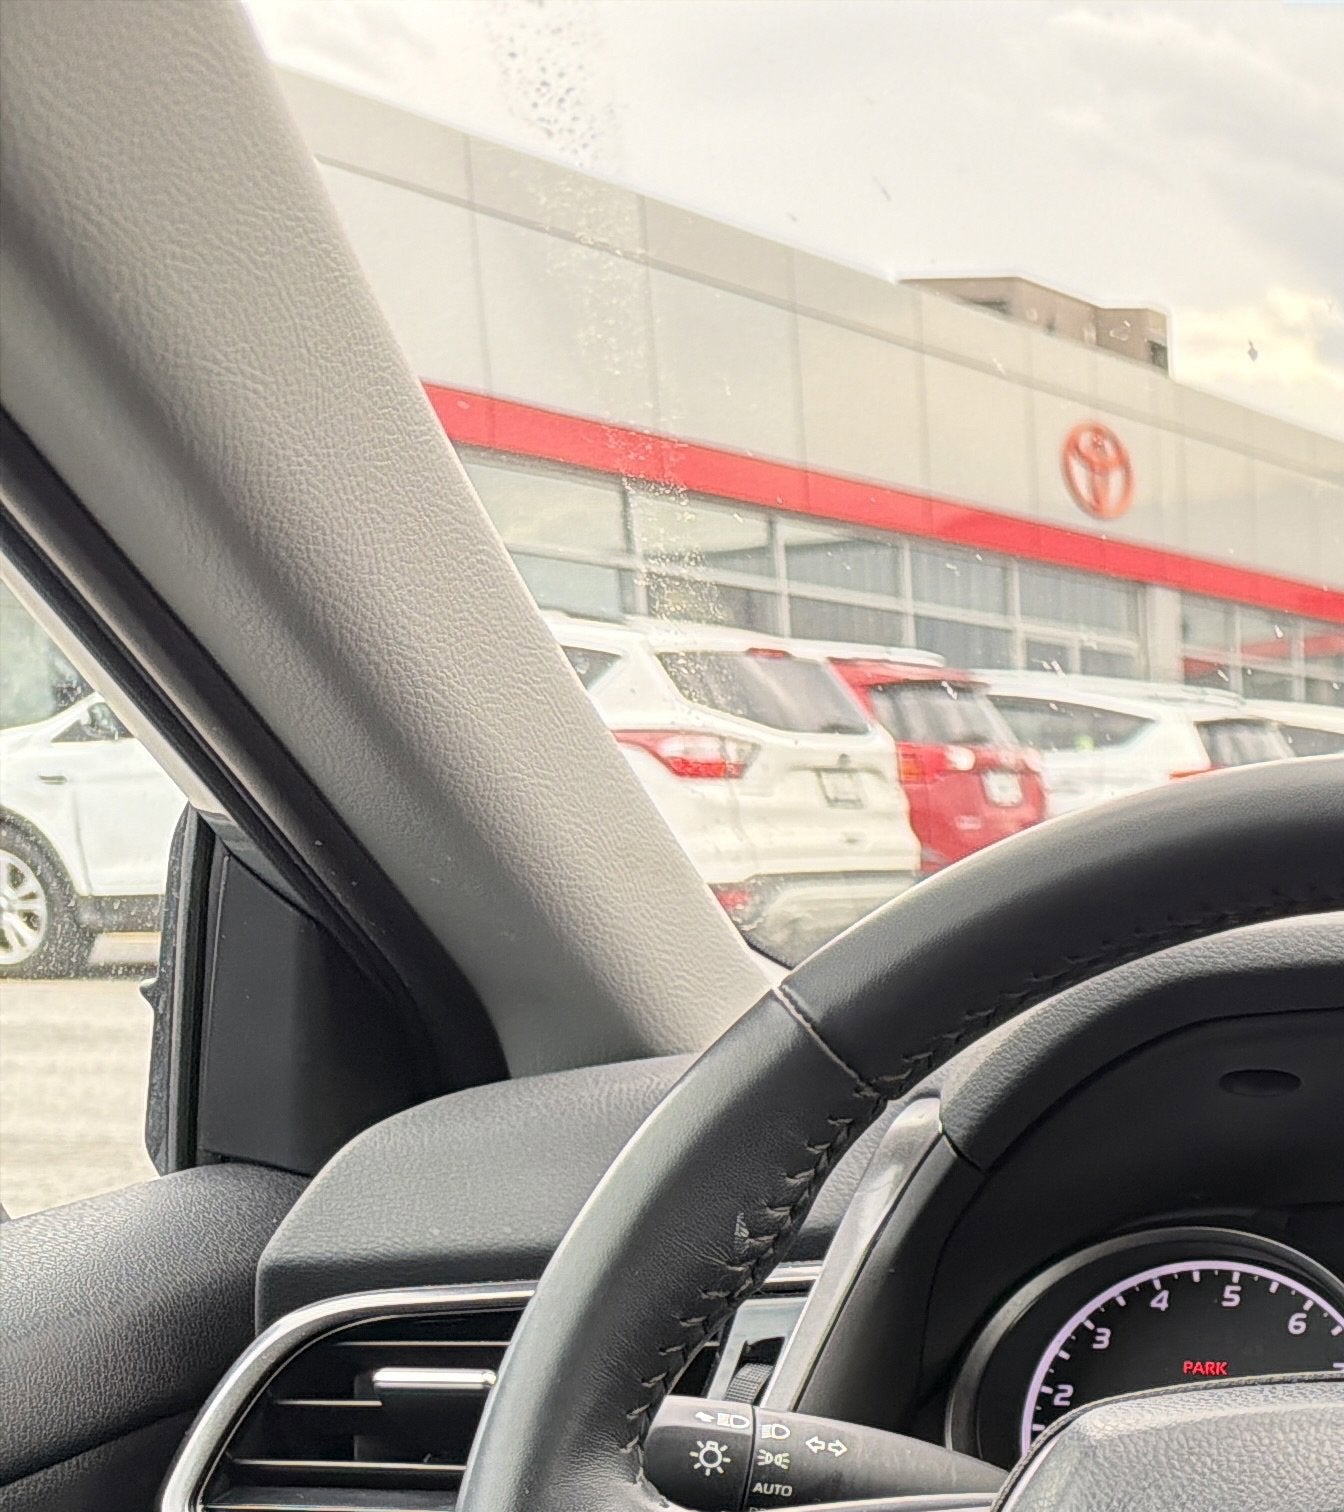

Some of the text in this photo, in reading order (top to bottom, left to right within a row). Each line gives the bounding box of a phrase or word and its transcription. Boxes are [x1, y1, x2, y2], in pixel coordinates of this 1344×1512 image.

[1150, 1290, 1169, 1312] 4
[1221, 1285, 1242, 1307] 5
[1288, 1313, 1308, 1335] 6
[1092, 1328, 1111, 1350] 3
[1183, 1360, 1228, 1376] PARK
[1053, 1385, 1074, 1407] 2
[752, 1482, 793, 1497] AUTO
